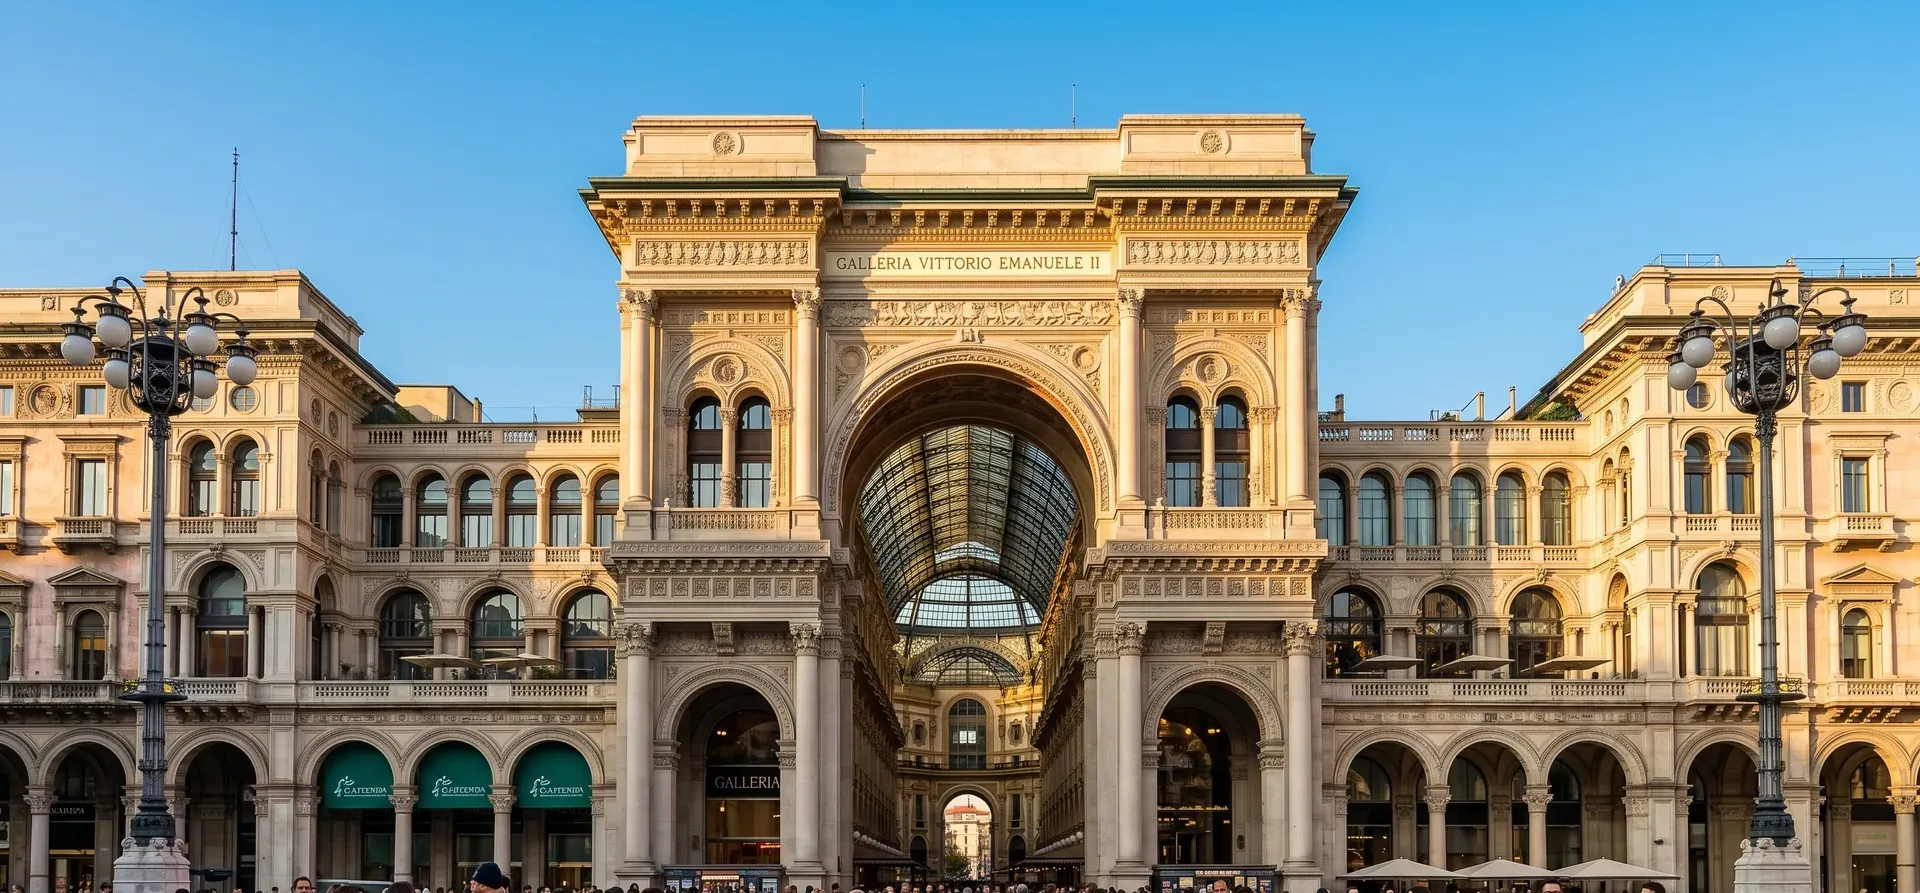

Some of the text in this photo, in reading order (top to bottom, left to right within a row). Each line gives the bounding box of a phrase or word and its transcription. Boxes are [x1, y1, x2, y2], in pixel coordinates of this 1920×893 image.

[836, 256, 1100, 270] GALLERIA VITTORIO EMANUELE II
[714, 776, 780, 789] GALLERIA
